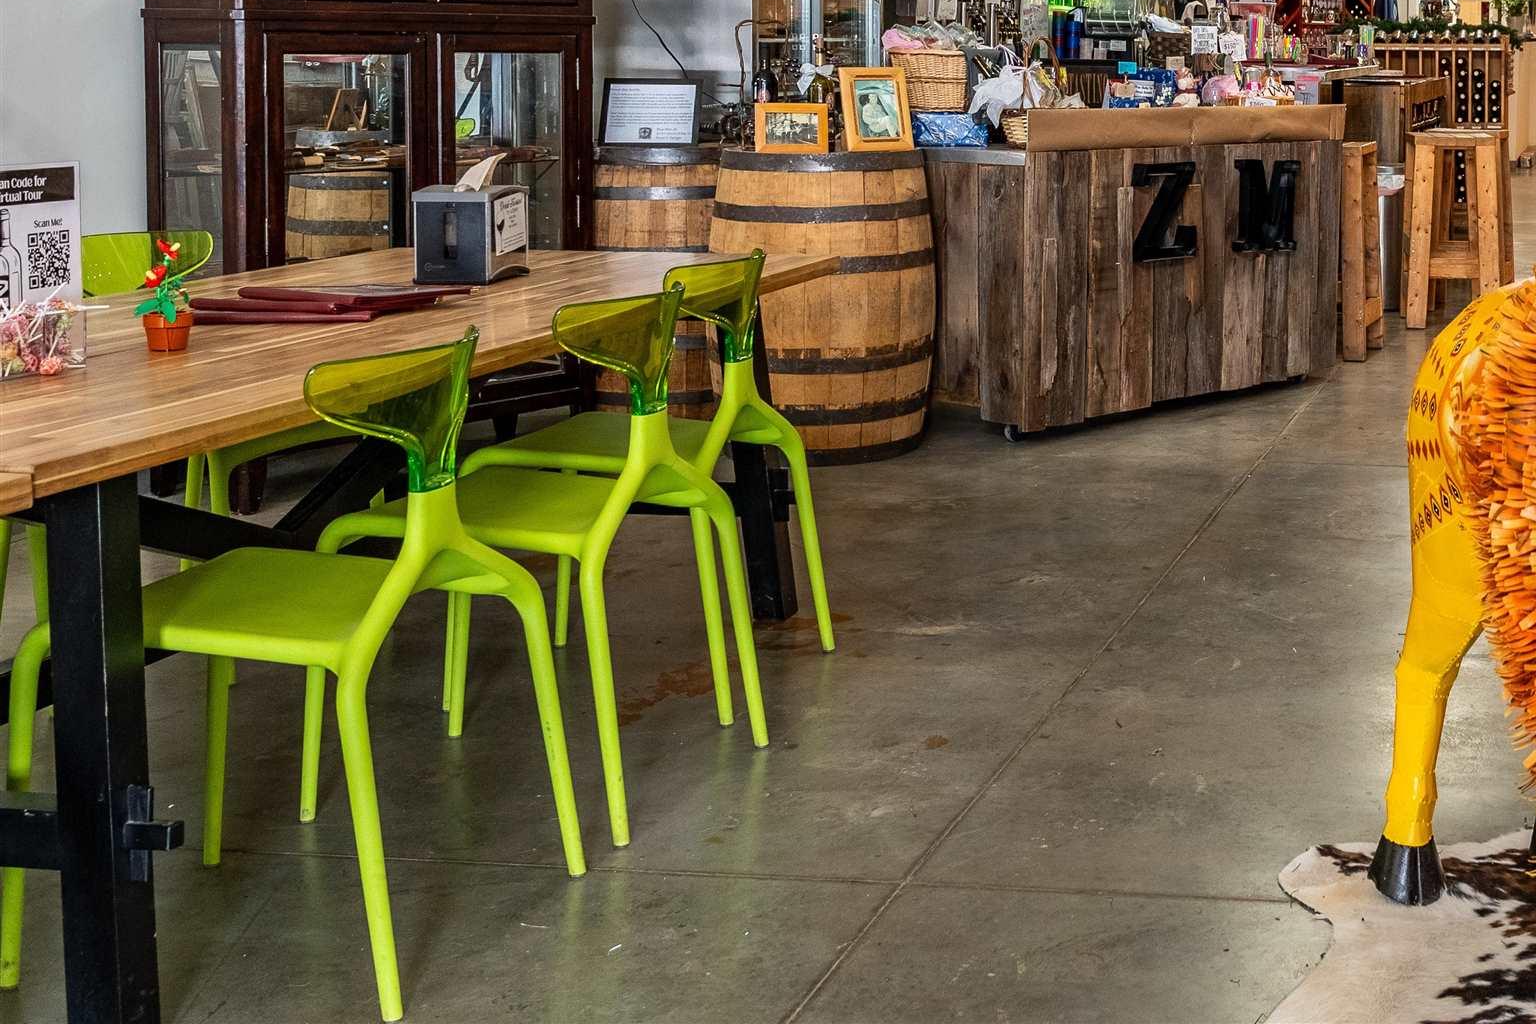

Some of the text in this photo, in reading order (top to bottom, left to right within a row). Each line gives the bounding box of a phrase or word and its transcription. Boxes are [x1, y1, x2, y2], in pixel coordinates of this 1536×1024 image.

[11, 177, 33, 188] Code
[34, 175, 47, 186] for
[0, 190, 44, 203] rtual Tour
[1132, 159, 1301, 263] Z M
[33, 217, 63, 228] Scan Me!
